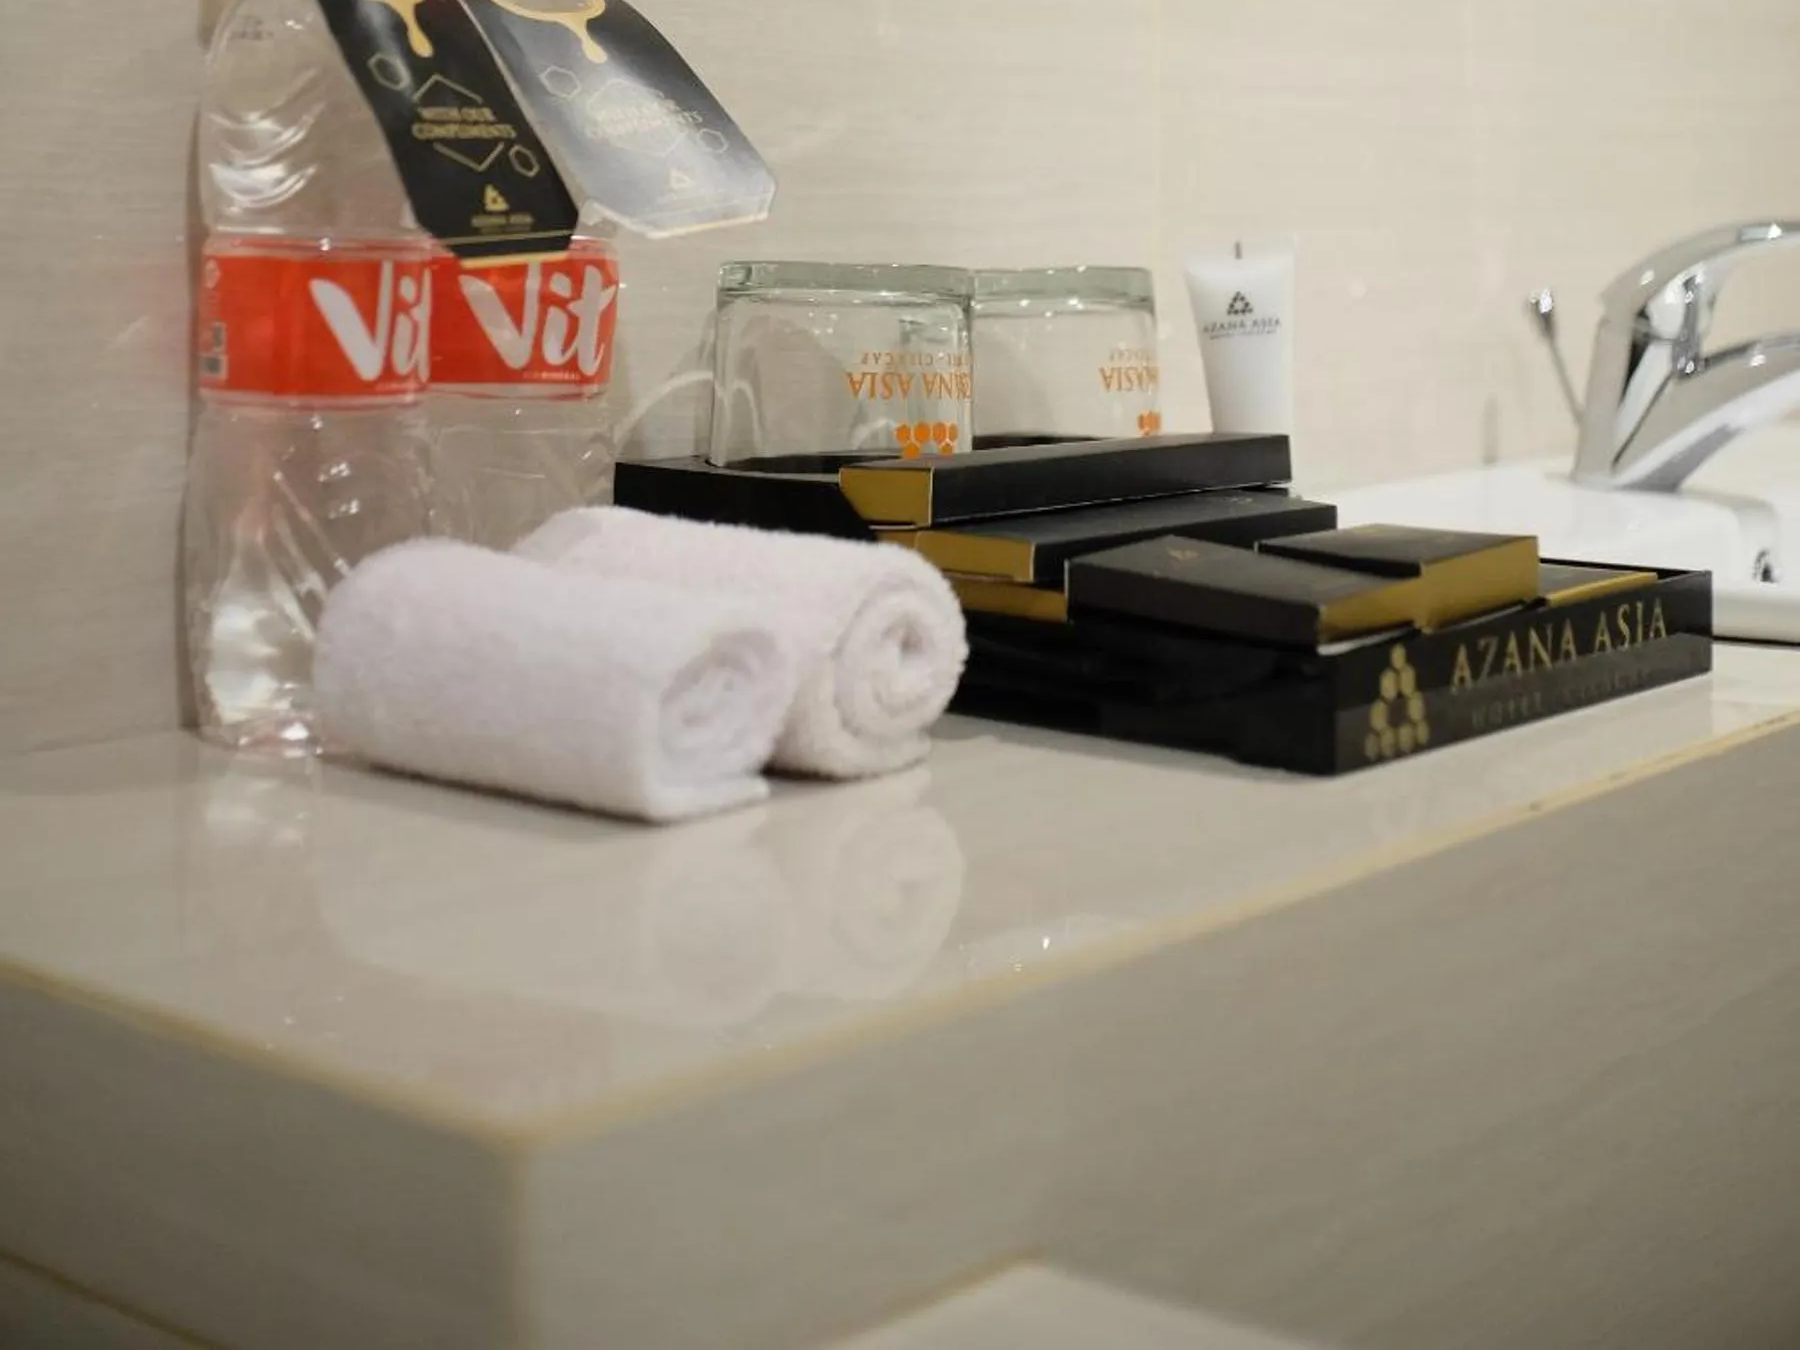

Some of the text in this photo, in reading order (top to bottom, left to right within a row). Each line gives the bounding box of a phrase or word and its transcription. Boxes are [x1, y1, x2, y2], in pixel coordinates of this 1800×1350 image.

[457, 261, 617, 376] Vit
[1451, 617, 1577, 696] AZANA
[1594, 598, 1668, 654] ASIA
